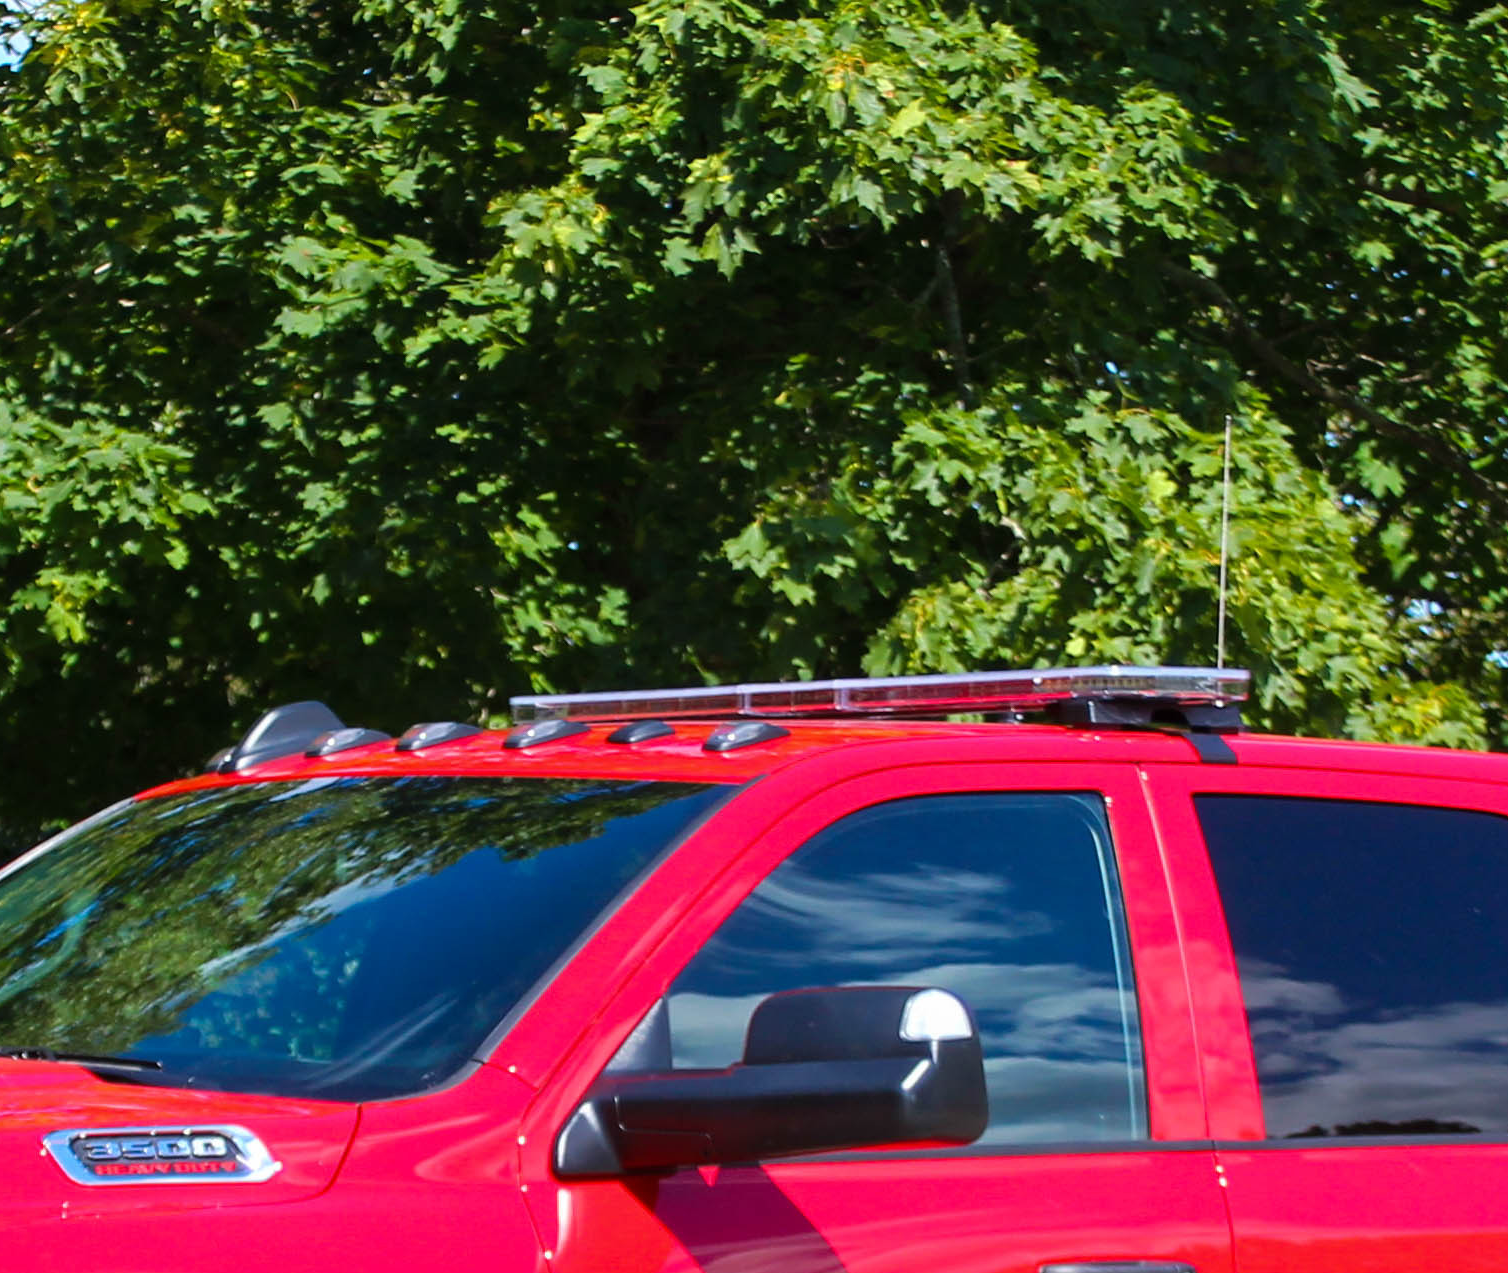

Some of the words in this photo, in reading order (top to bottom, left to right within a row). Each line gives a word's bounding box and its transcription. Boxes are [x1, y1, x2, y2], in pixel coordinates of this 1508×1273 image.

[85, 1136, 229, 1161] 3500
[93, 1163, 172, 1176] HEAVY
[173, 1161, 237, 1174] DUTY
